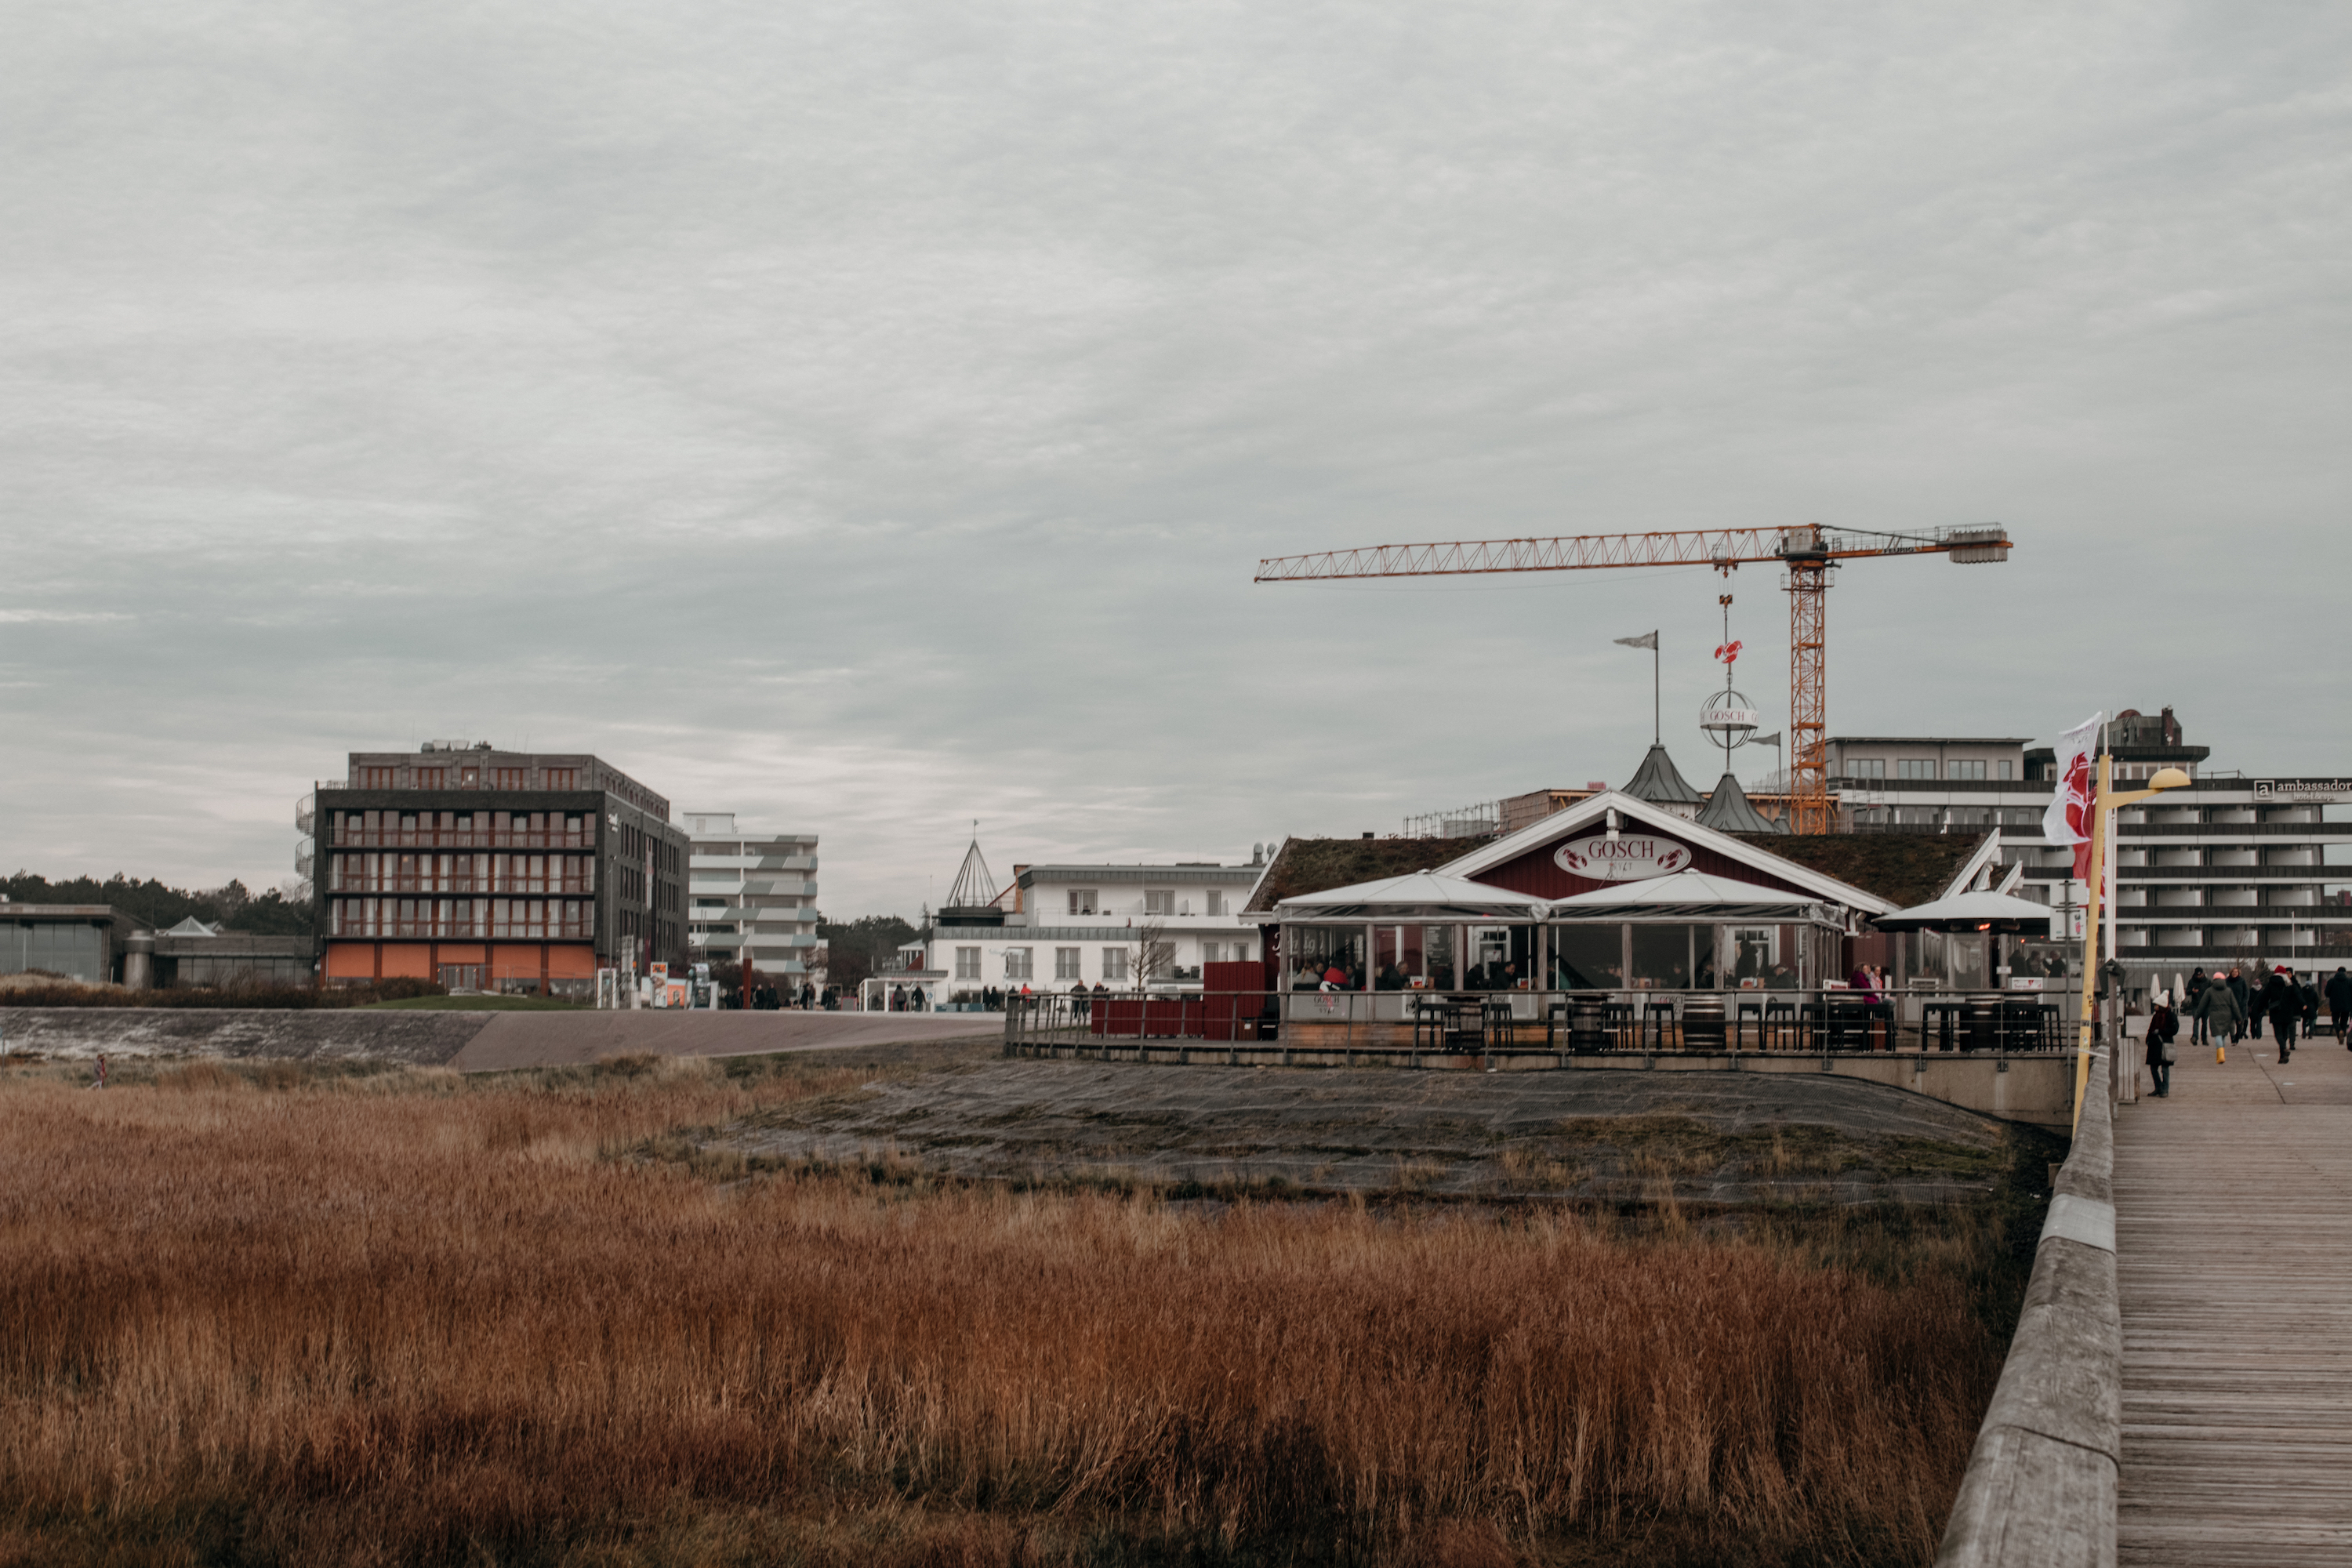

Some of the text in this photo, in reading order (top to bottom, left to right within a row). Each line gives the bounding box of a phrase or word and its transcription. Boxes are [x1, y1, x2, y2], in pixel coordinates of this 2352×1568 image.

[1710, 710, 1744, 721] GOSCH
[2259, 784, 2270, 797] a
[2277, 779, 2352, 792] ambassador
[2293, 790, 2314, 800] hotel
[2323, 792, 2336, 801] spa
[1588, 840, 1655, 858] GOSCH
